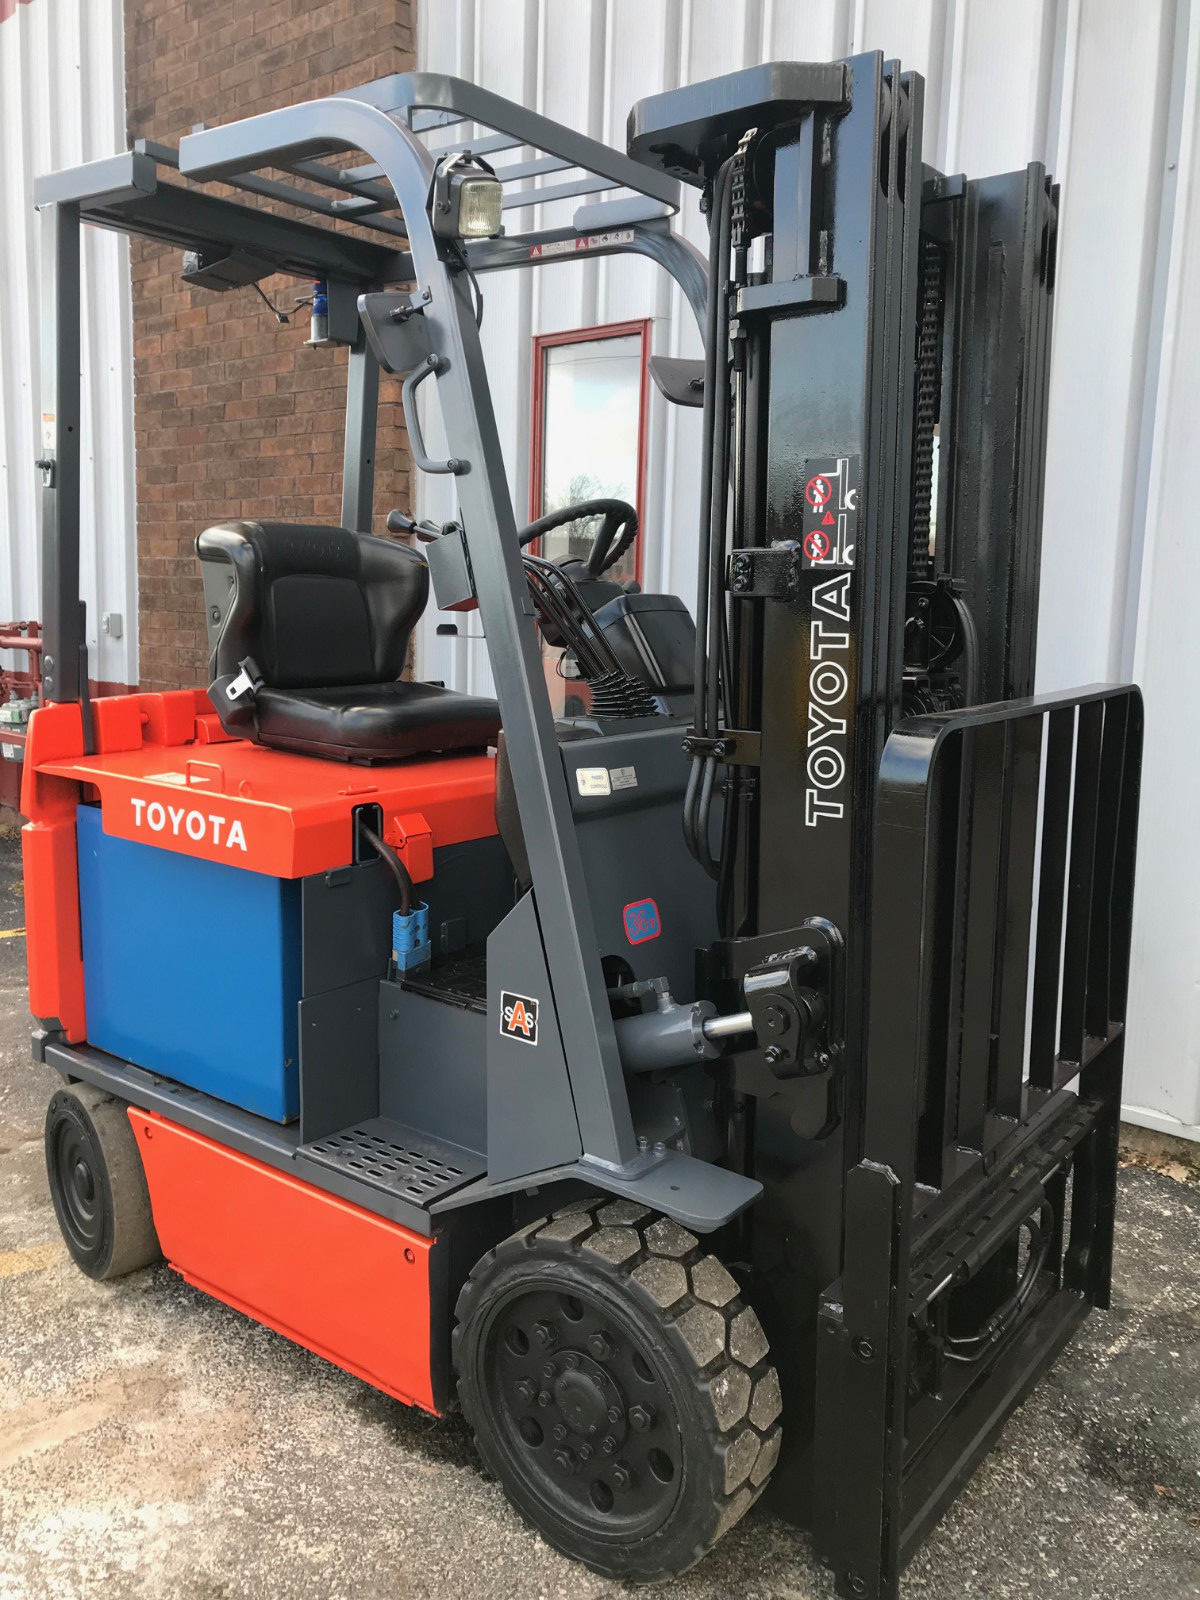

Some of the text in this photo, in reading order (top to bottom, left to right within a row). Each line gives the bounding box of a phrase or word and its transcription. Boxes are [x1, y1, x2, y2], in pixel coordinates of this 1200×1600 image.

[805, 572, 851, 827] TOYOTA
[130, 797, 248, 852] TOYOTA
[504, 1000, 534, 1036] SAS
